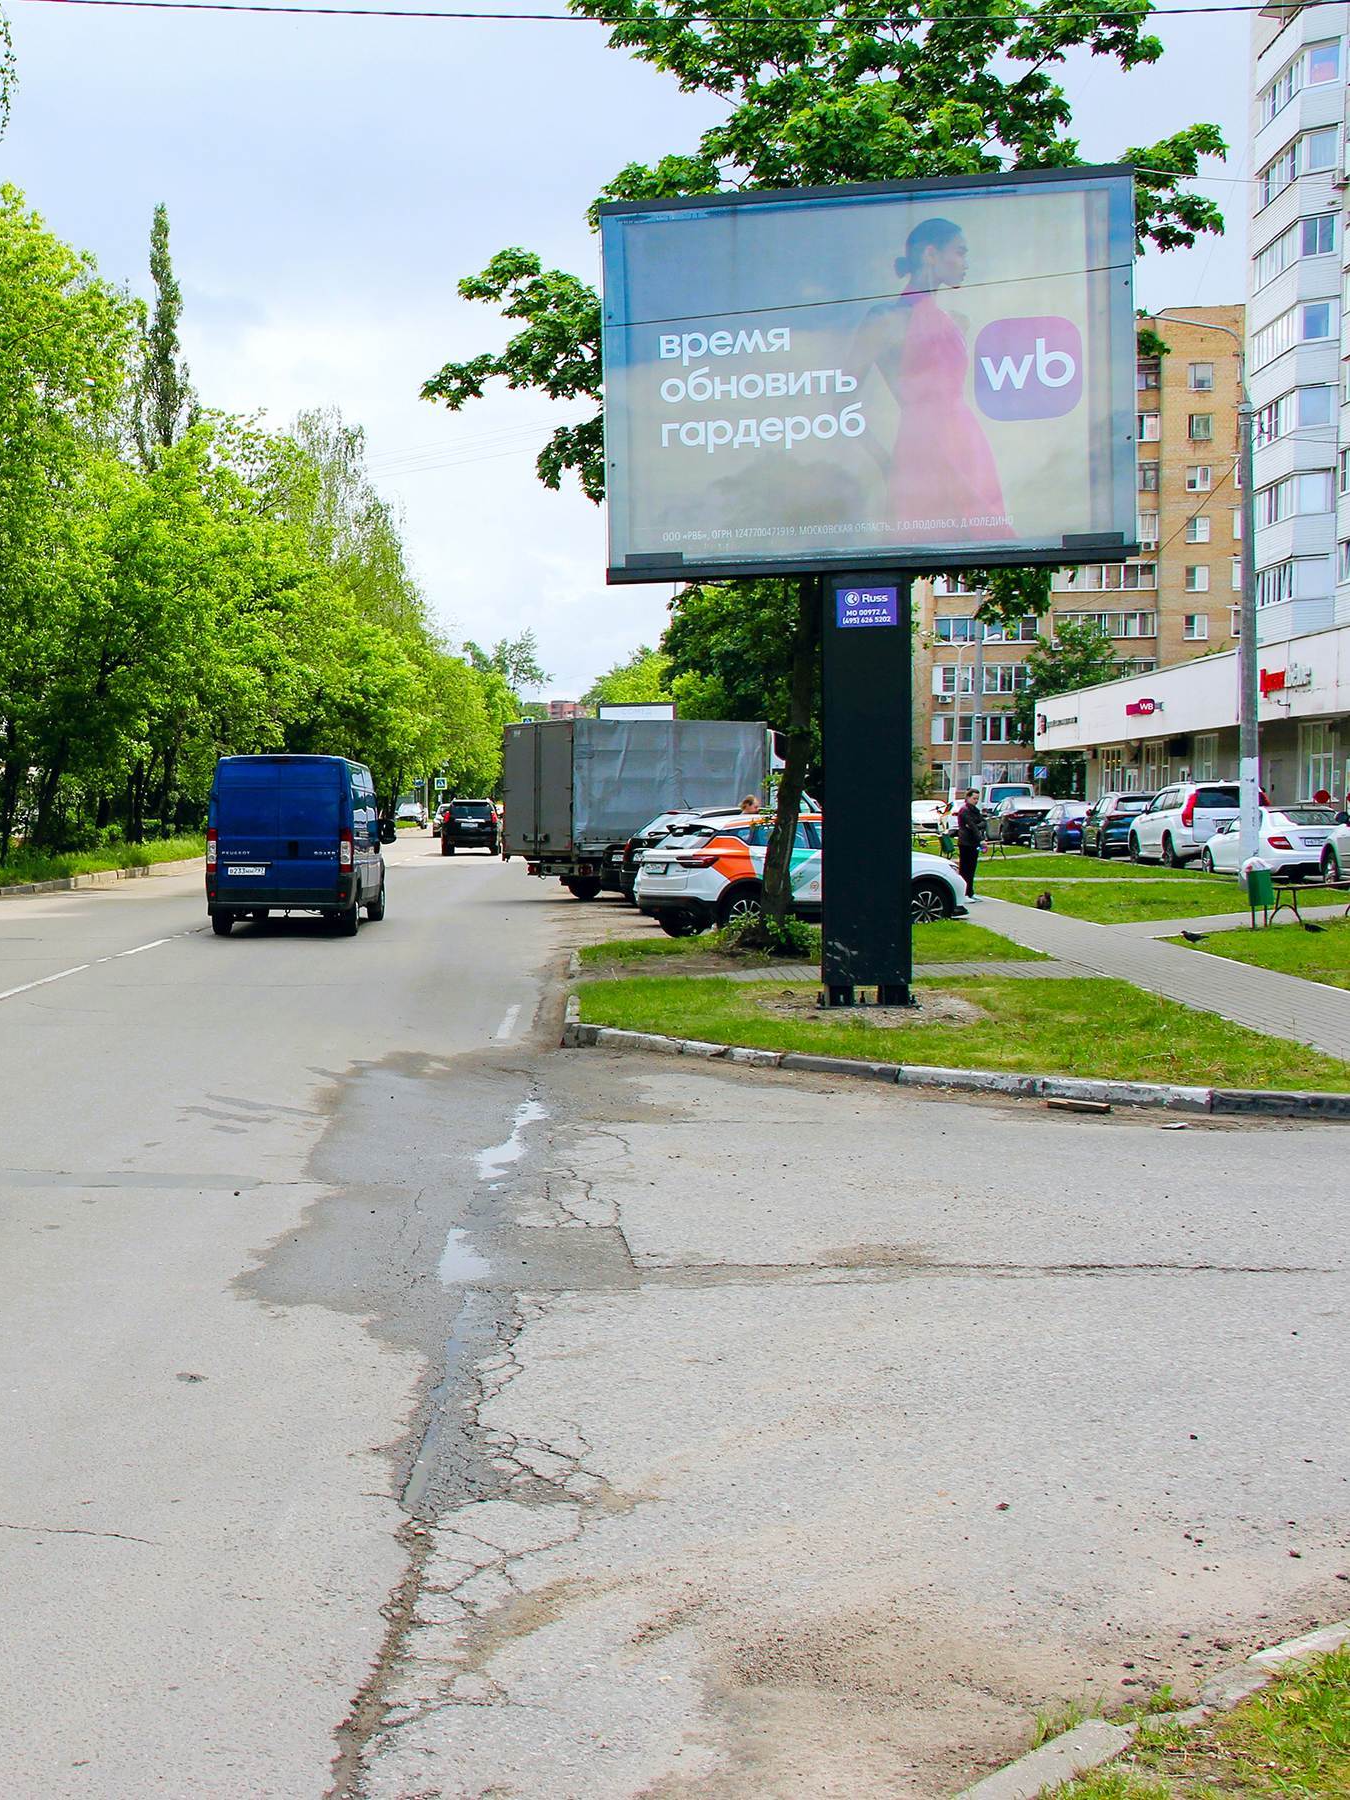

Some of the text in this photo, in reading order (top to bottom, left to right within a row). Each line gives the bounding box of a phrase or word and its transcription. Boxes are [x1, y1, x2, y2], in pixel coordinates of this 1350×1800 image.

[659, 327, 791, 366] время
[980, 338, 1076, 391] wb
[660, 366, 858, 404] обновить
[660, 401, 867, 454] гардероб
[662, 531, 681, 542] ООО
[712, 527, 732, 540] ОГРН
[861, 593, 889, 603] Russ
[842, 615, 892, 625] (495) 626 5202
[1139, 702, 1154, 711] WB
